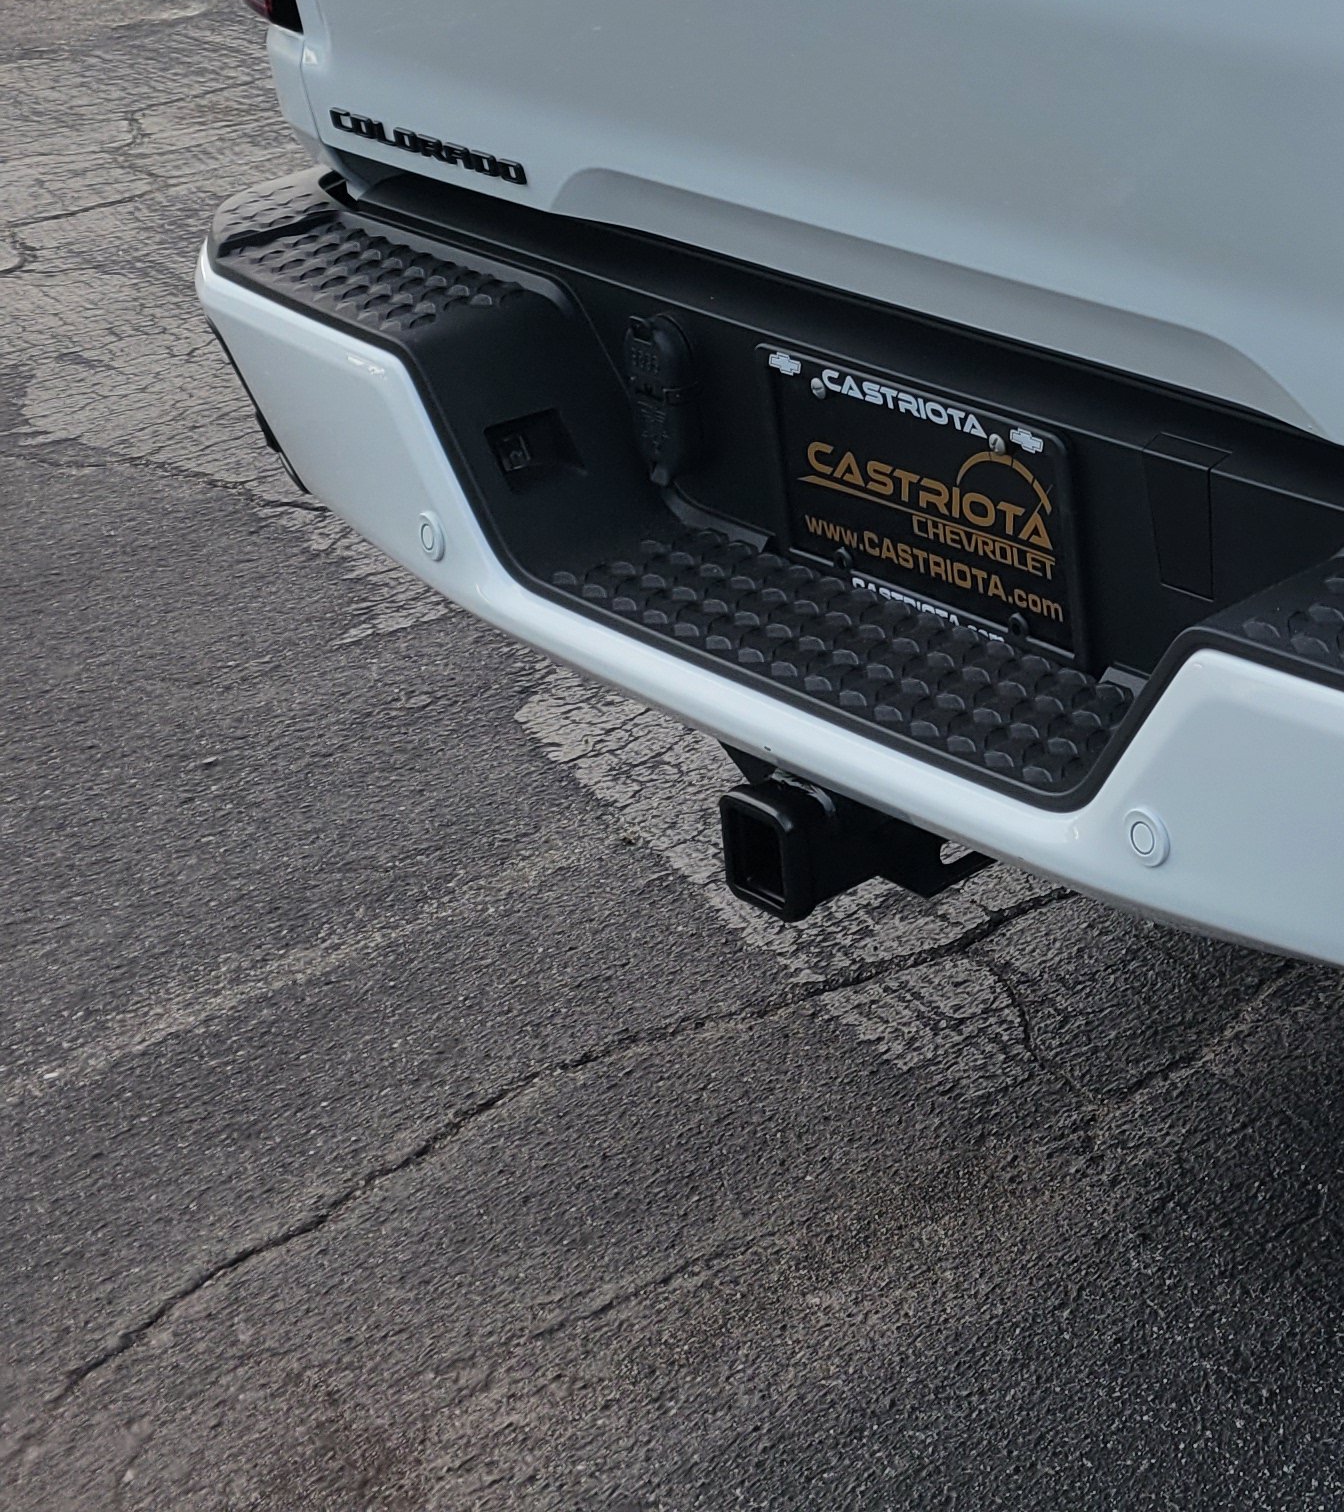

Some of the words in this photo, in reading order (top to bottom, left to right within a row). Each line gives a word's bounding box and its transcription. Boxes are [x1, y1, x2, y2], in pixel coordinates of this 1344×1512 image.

[329, 106, 528, 185] COLORADO
[821, 368, 989, 439] CASTRIOTA
[806, 441, 1054, 550] CASTRIOTA
[804, 514, 1064, 622] www.CASTRIOTA.com
[911, 514, 1056, 580] CHEVROLET
